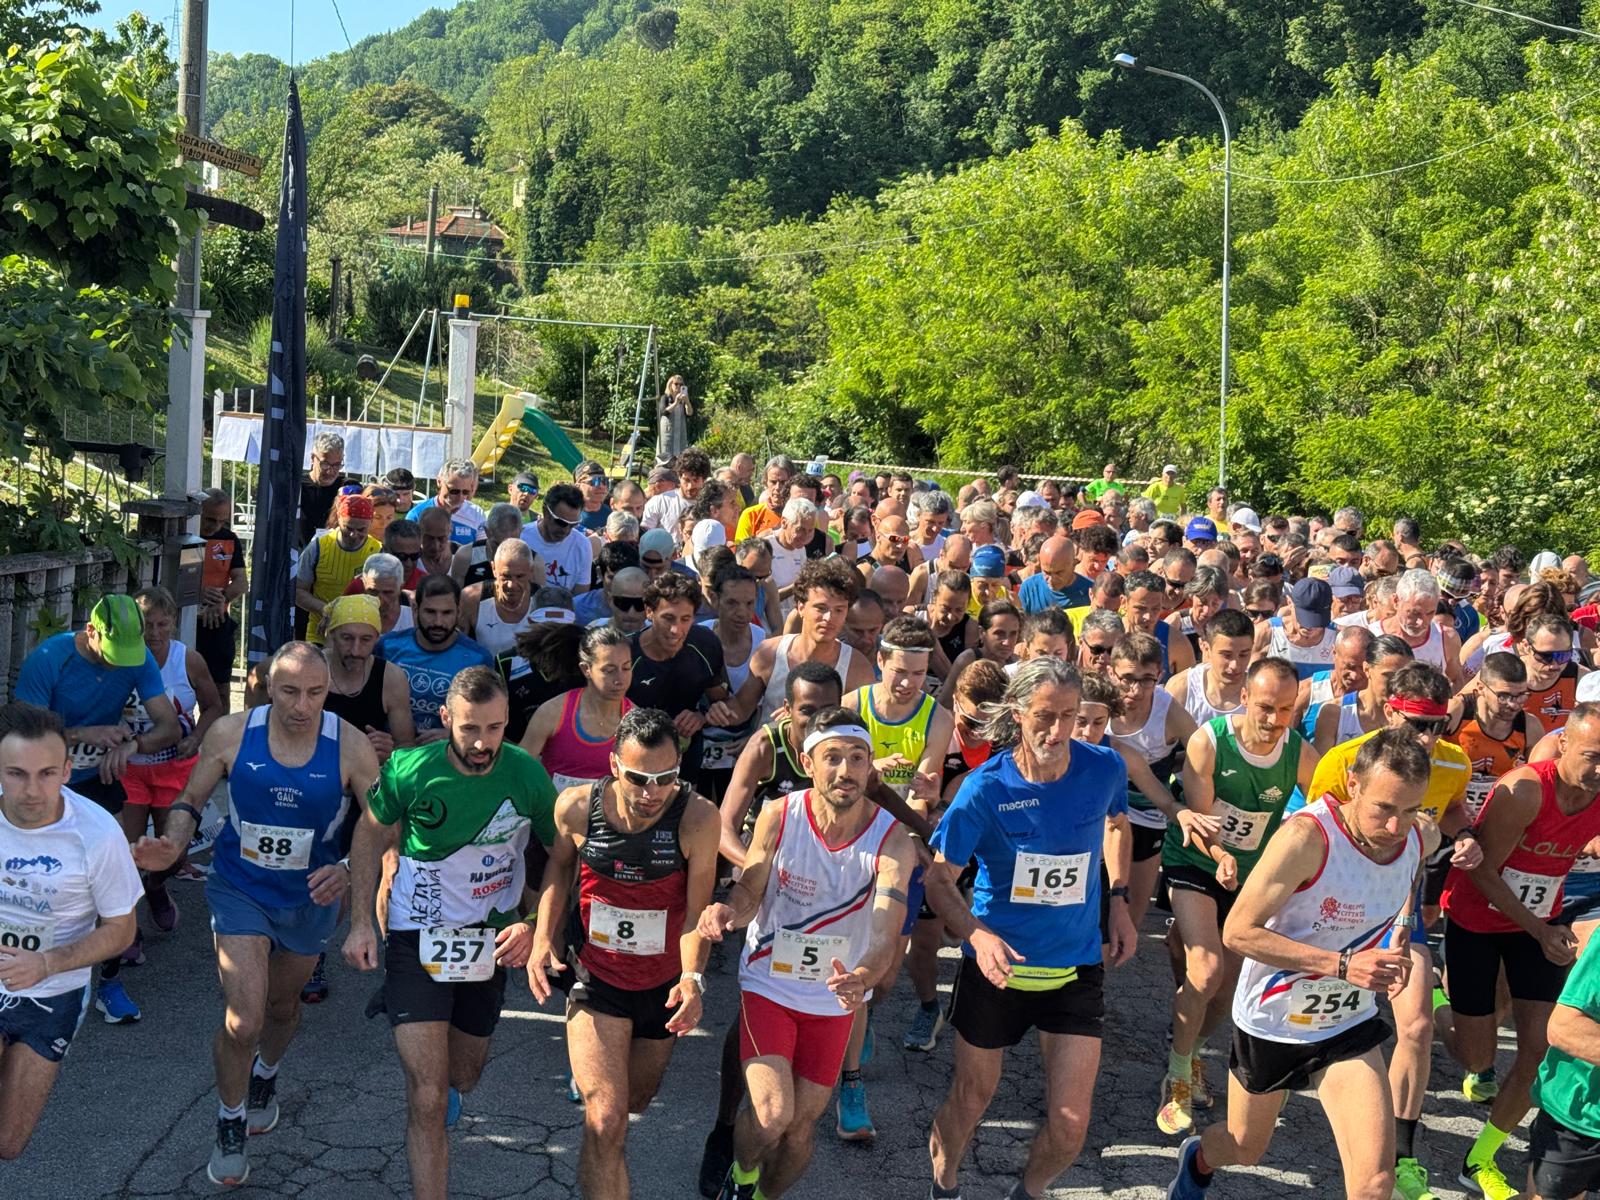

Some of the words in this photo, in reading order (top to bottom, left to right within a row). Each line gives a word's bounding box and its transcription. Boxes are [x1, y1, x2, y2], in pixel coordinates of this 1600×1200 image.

[274, 801, 299, 809] GENOVA
[276, 791, 295, 802] GAU
[998, 798, 1040, 812] macron
[1221, 815, 1254, 837] 33
[258, 836, 293, 857] 88
[1028, 867, 1079, 889] 165
[1519, 884, 1548, 905] 13
[616, 920, 635, 940] 8
[430, 940, 486, 963] 257
[800, 946, 819, 966] 5
[1301, 989, 1361, 1015] 254
